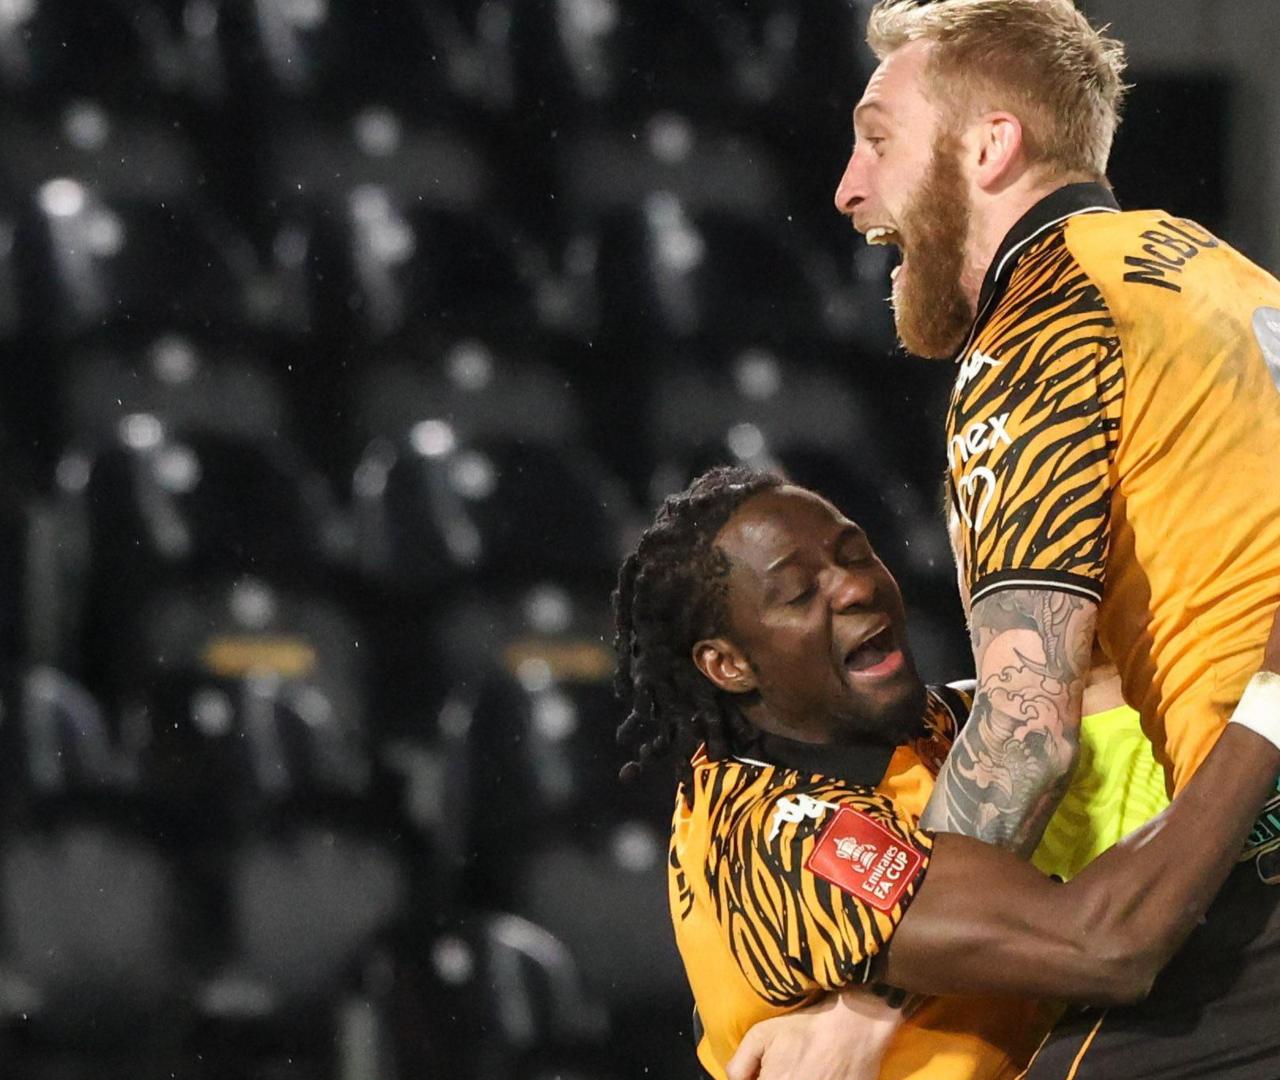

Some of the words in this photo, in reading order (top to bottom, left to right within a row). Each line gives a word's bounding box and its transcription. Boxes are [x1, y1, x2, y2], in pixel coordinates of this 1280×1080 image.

[861, 844, 899, 893] Emirates
[873, 880, 895, 900] FA
[886, 850, 909, 880] CUP
